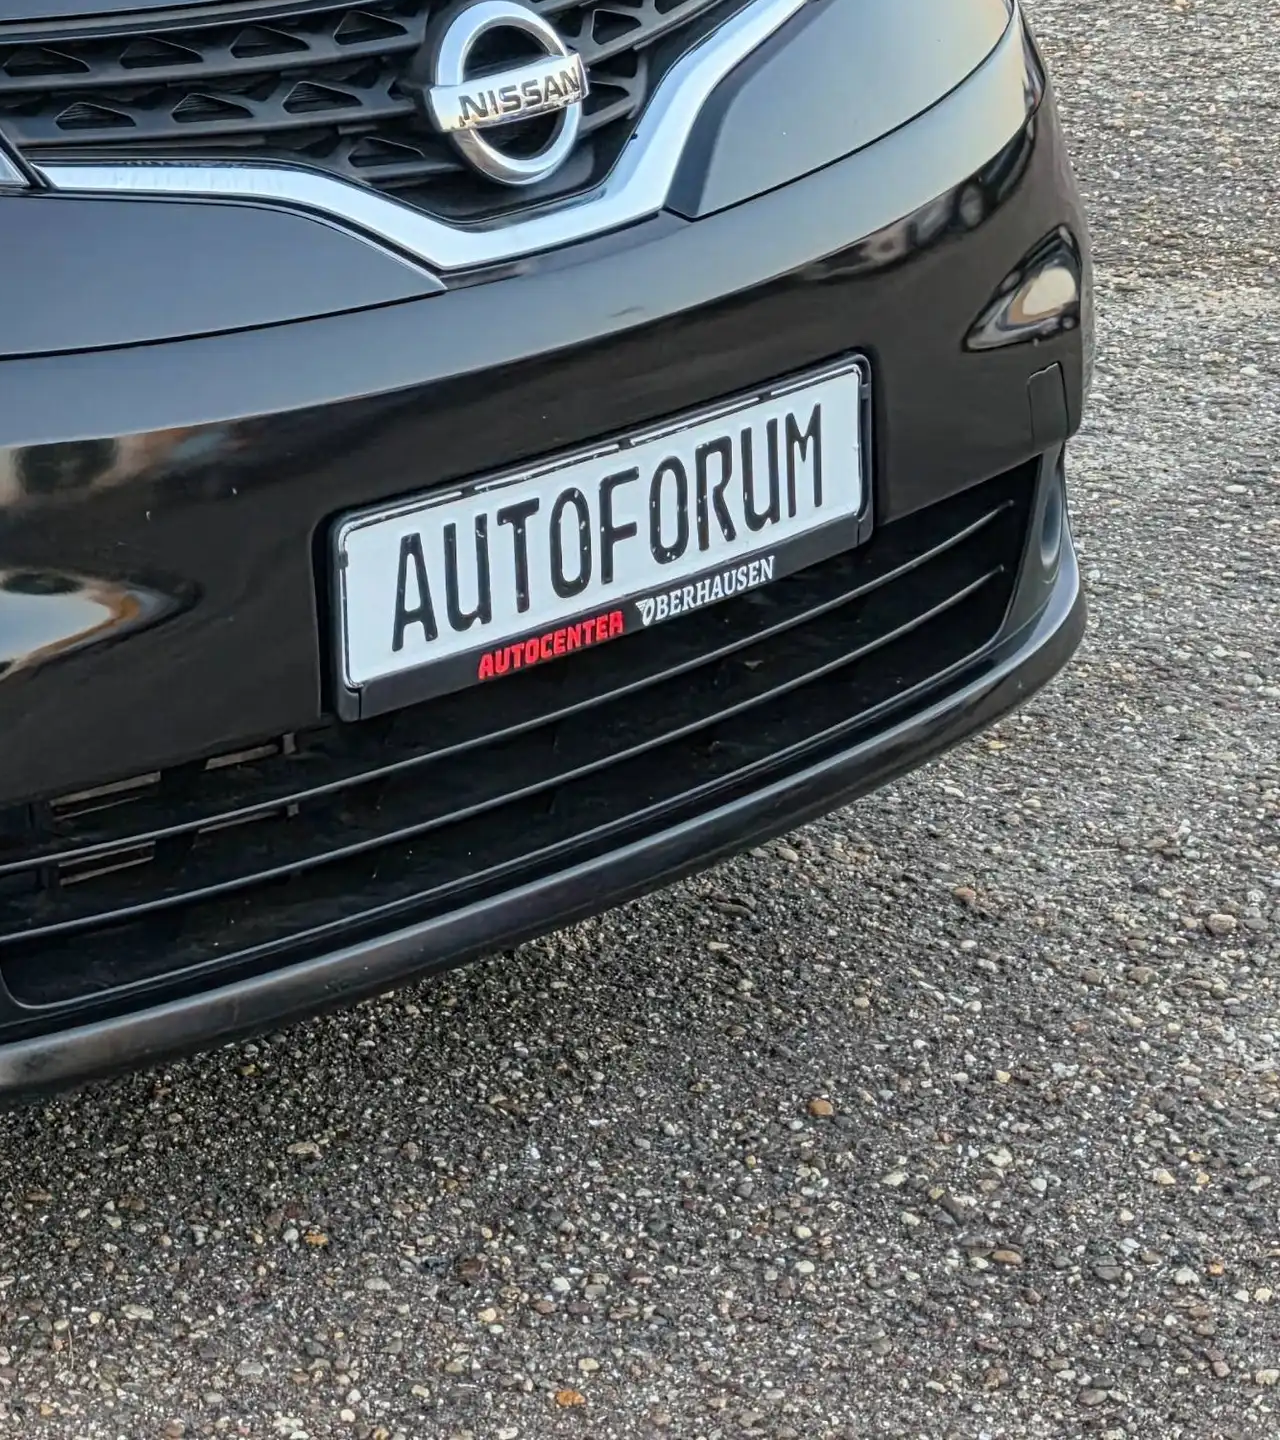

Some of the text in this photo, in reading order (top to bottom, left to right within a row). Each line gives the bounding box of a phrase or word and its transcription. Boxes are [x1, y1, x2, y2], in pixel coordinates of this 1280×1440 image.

[458, 66, 580, 120] NISSAN
[392, 403, 823, 652] AUTOFORUM
[478, 555, 775, 680] AUTOCENTER OBERHAUSEN
